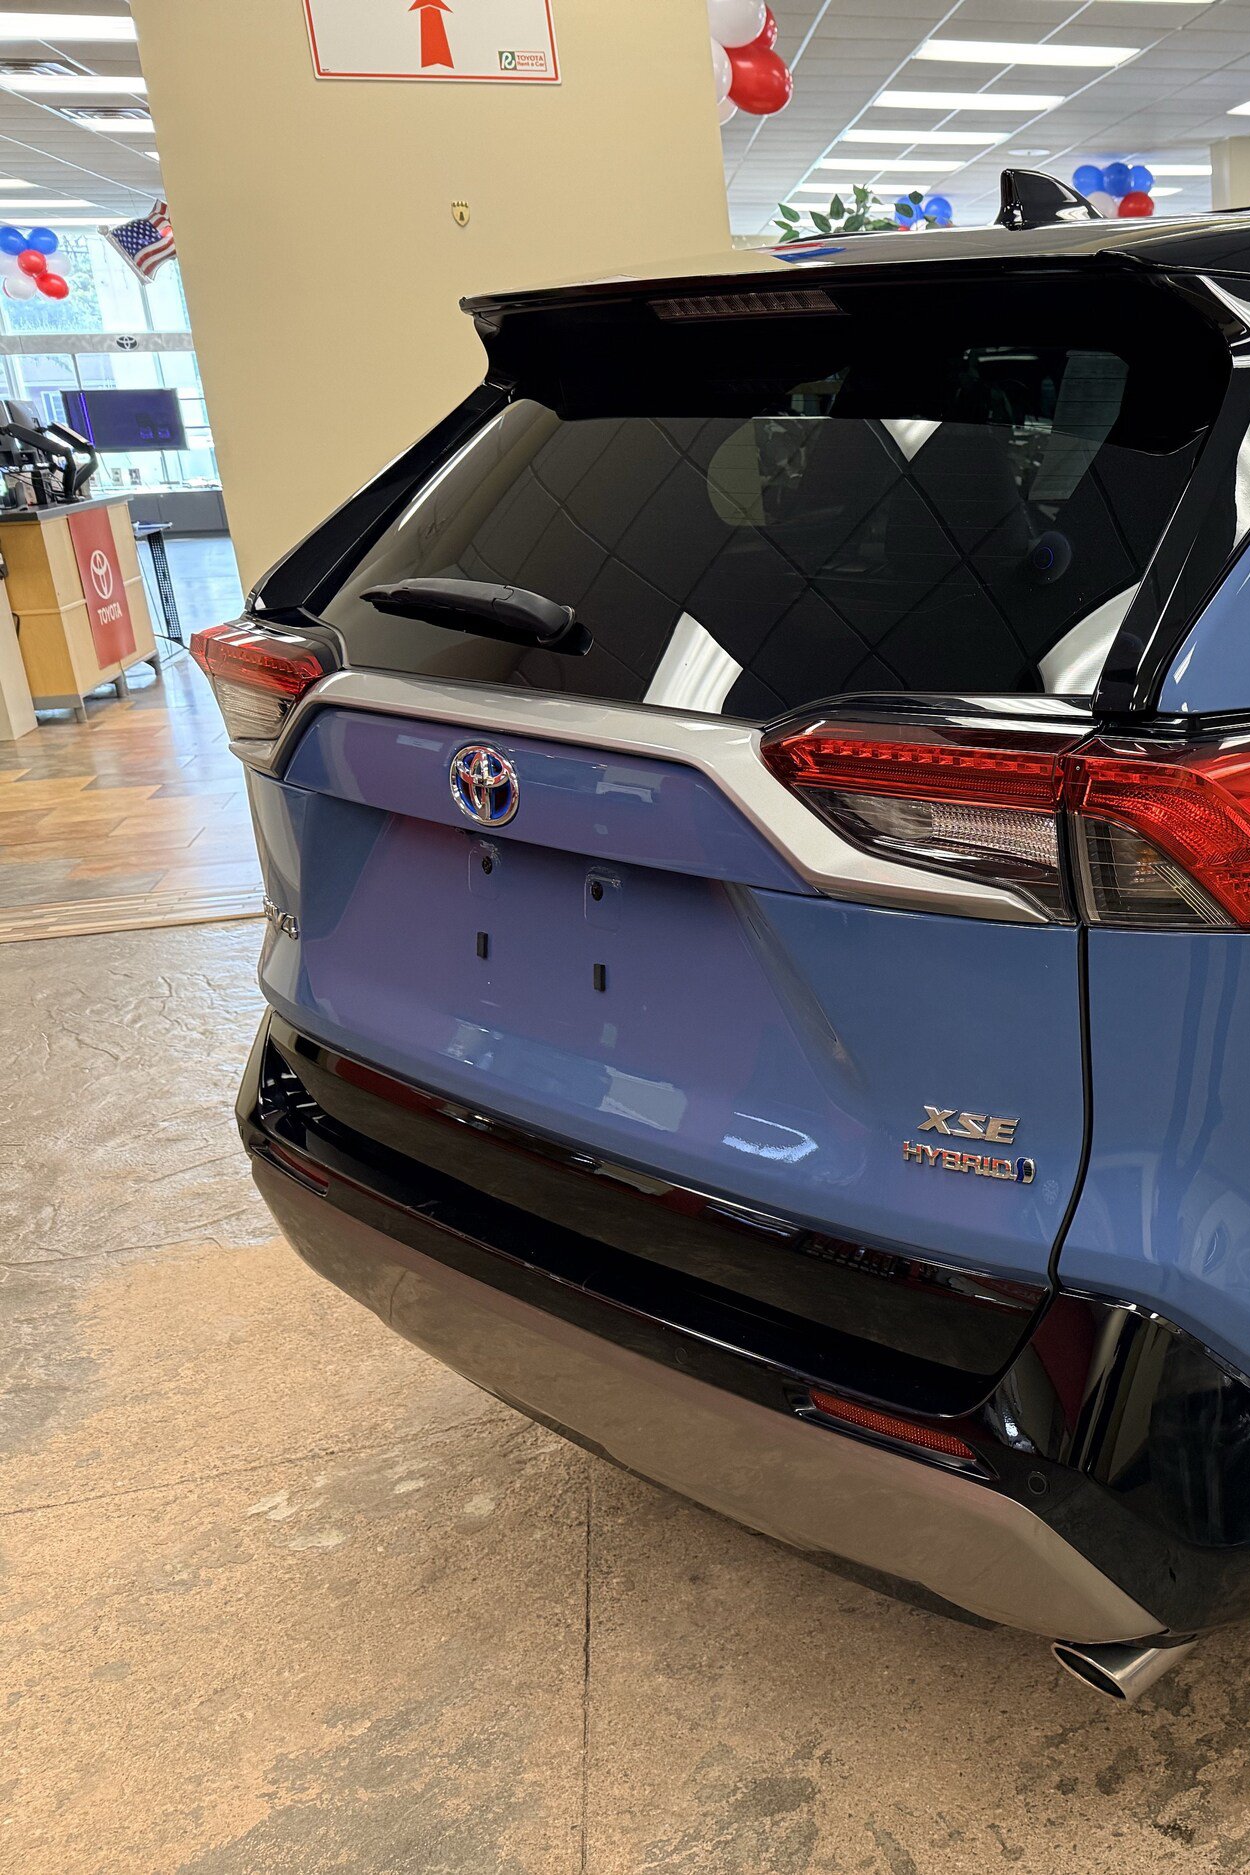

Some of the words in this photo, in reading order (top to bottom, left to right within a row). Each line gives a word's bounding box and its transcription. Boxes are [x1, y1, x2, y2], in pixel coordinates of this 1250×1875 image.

[97, 602, 122, 626] TOYOTA
[916, 1104, 1021, 1145] XSE
[902, 1139, 1013, 1180] HYBRID
